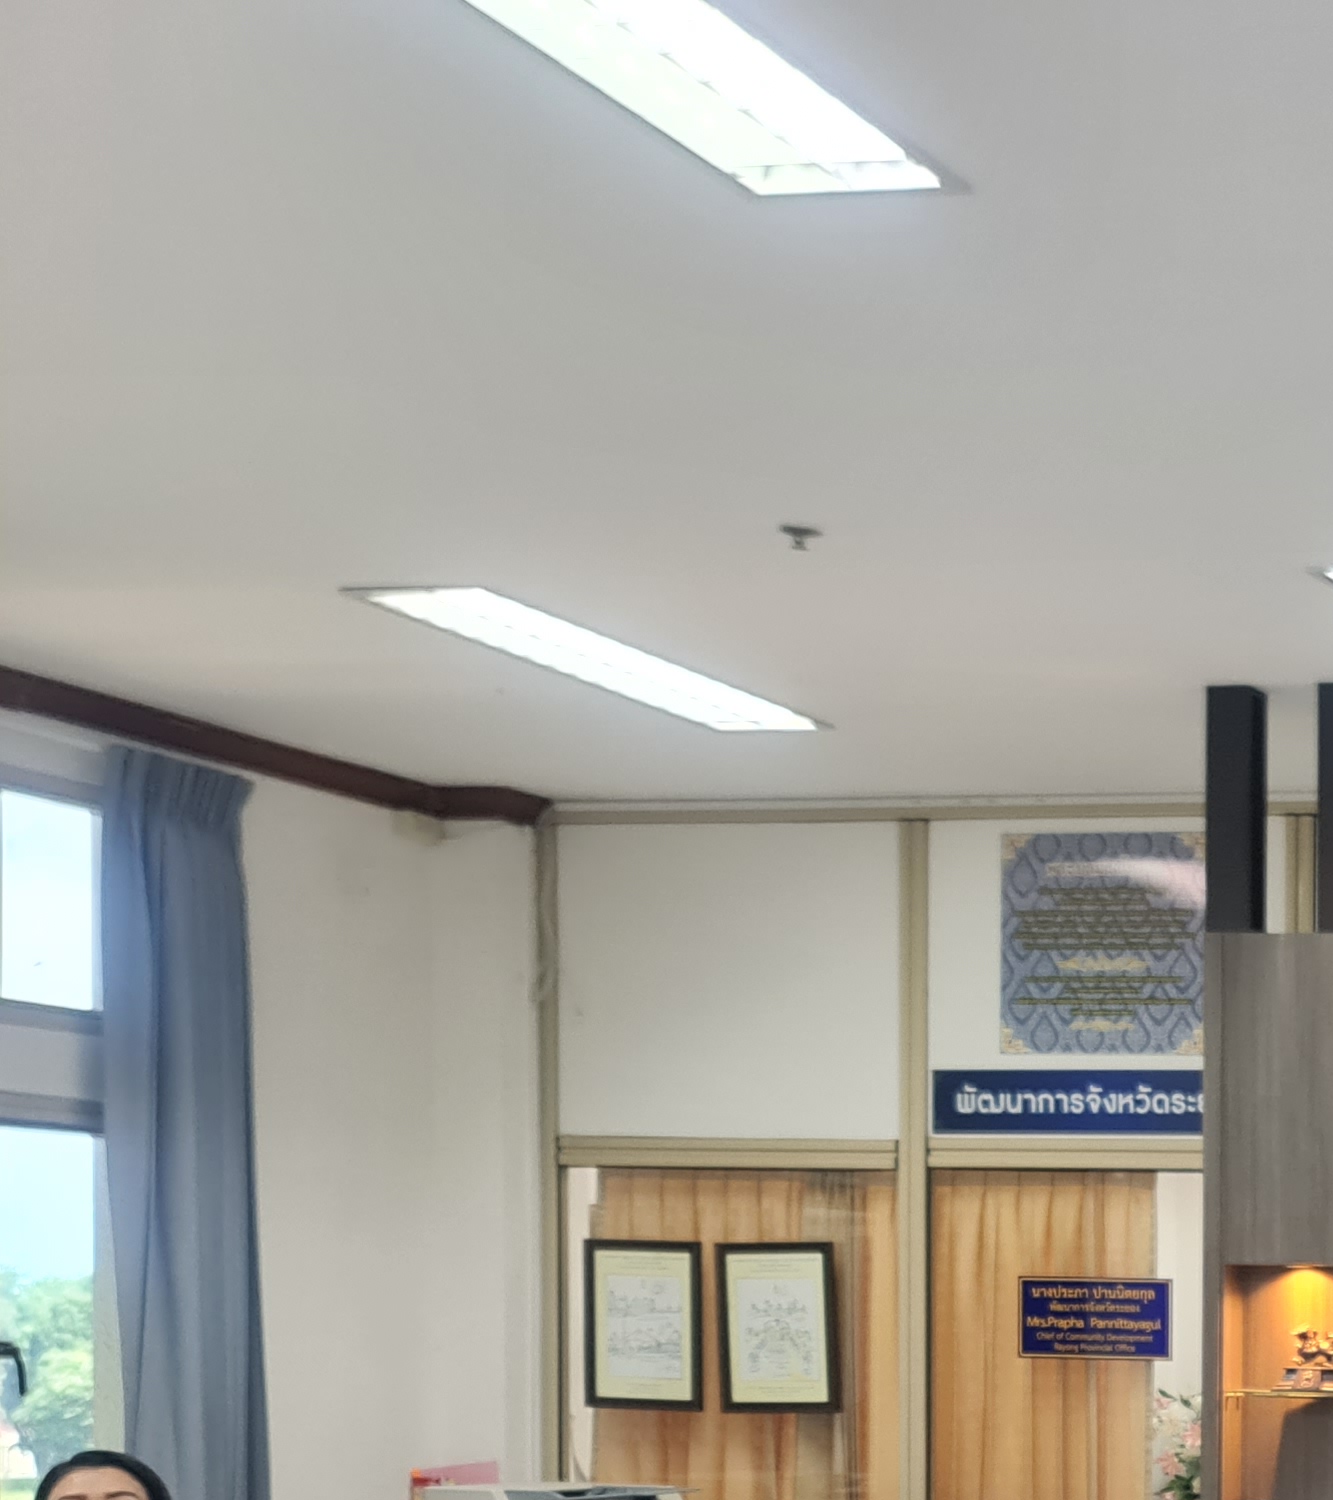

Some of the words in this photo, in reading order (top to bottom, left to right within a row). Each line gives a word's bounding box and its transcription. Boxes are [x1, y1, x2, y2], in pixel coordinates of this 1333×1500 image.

[954, 1083, 1203, 1115] พัฒนาการจังหวัดระ
